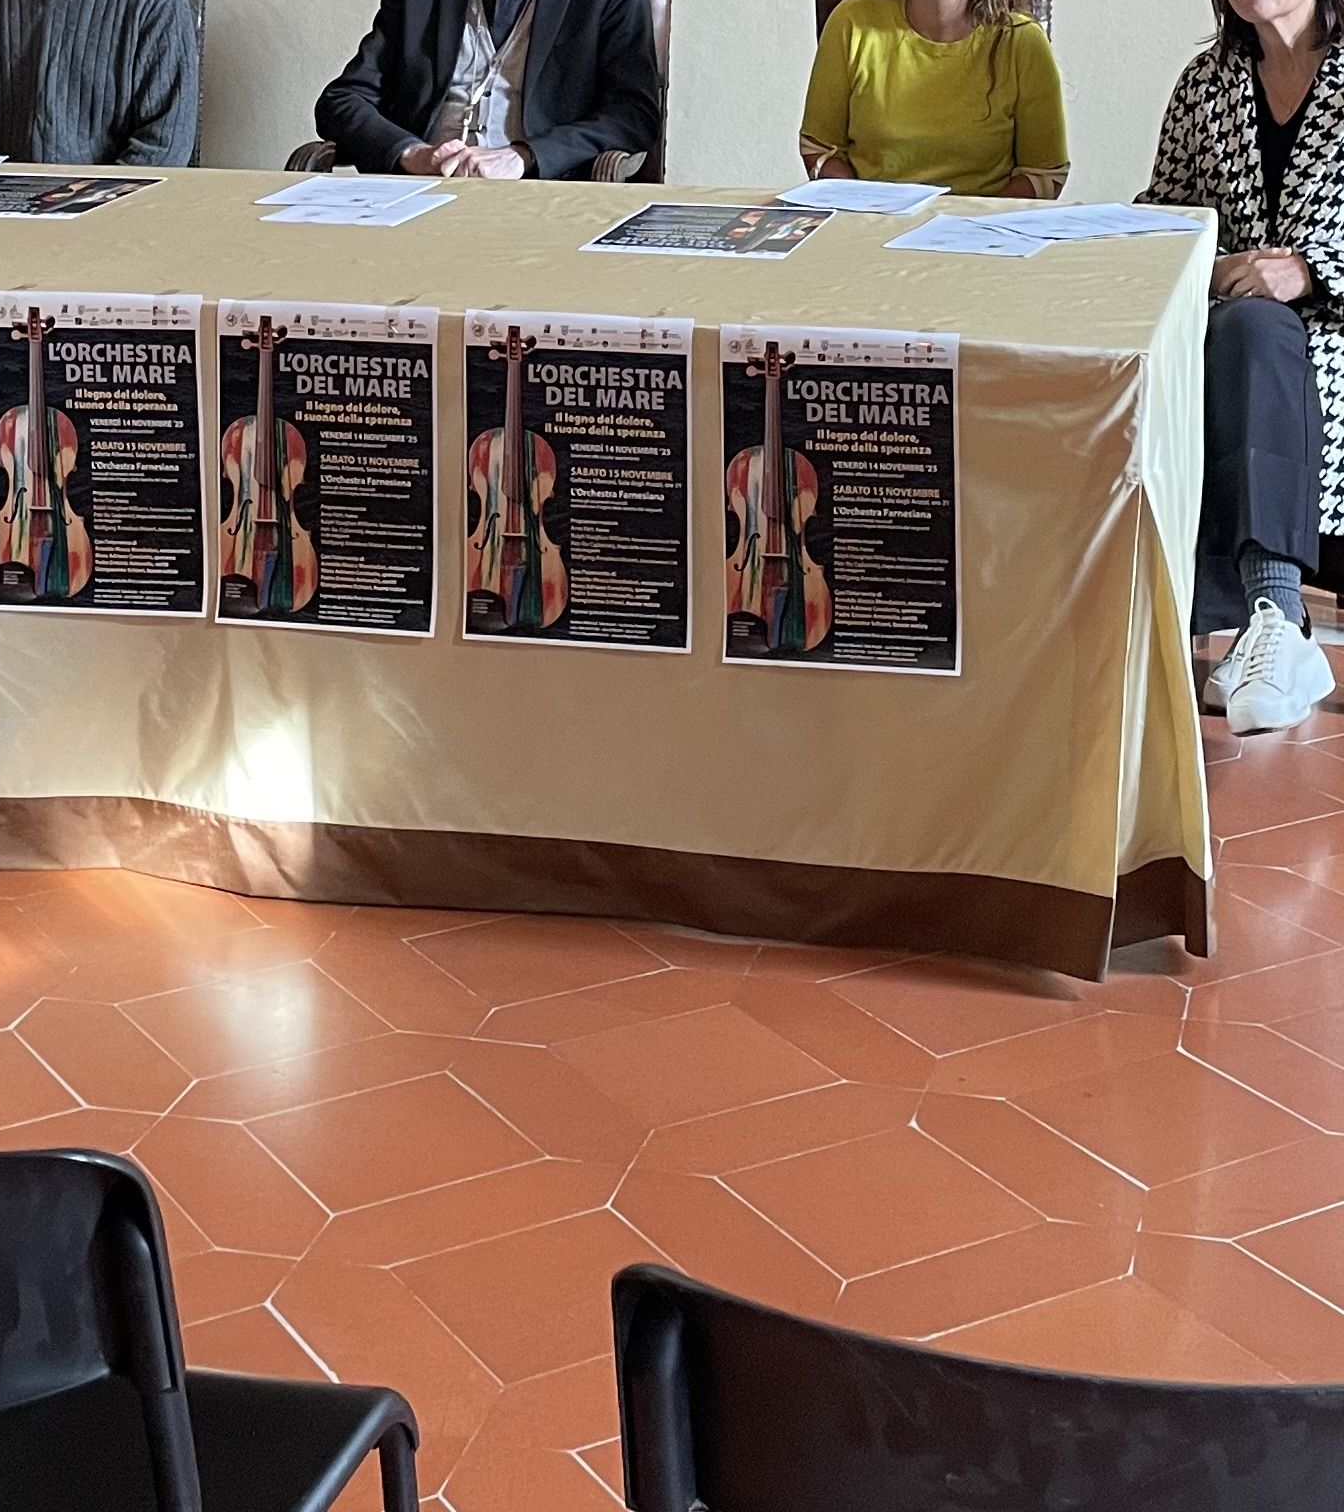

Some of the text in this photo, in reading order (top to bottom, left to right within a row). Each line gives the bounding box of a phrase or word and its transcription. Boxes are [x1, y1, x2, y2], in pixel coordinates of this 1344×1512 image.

[48, 343, 192, 363] L'ORCHESTRA
[279, 353, 429, 378] L'ORCHESTRA
[66, 364, 176, 384] DEL MARE
[528, 364, 683, 390] L'ORCHESTRA
[297, 375, 411, 399] DEL MARE
[787, 380, 949, 405] L'ORCHESTRA
[84, 389, 112, 401] legno
[114, 390, 130, 399] del
[546, 387, 664, 410] DEL MARE
[106, 400, 131, 410] della
[133, 403, 178, 413] speranza
[315, 401, 344, 414] legno
[346, 402, 362, 412] del
[304, 413, 335, 422] suono
[338, 413, 363, 423] della
[365, 416, 412, 428] speranza
[565, 413, 595, 426] legno
[597, 414, 614, 424] del
[806, 403, 930, 426] DEL MARE
[554, 425, 586, 434] suono
[588, 425, 614, 436] della
[617, 429, 665, 440] speranza
[827, 430, 858, 443] legno
[860, 431, 878, 441] del
[815, 443, 849, 451] suono
[851, 442, 878, 453] della
[881, 445, 931, 457] speranza
[320, 454, 355, 464] SABATO
[571, 467, 606, 477] SABATO
[621, 470, 673, 481] NOVEMBRE
[833, 485, 870, 495] SABATO
[886, 487, 940, 498] NOVEMBRE
